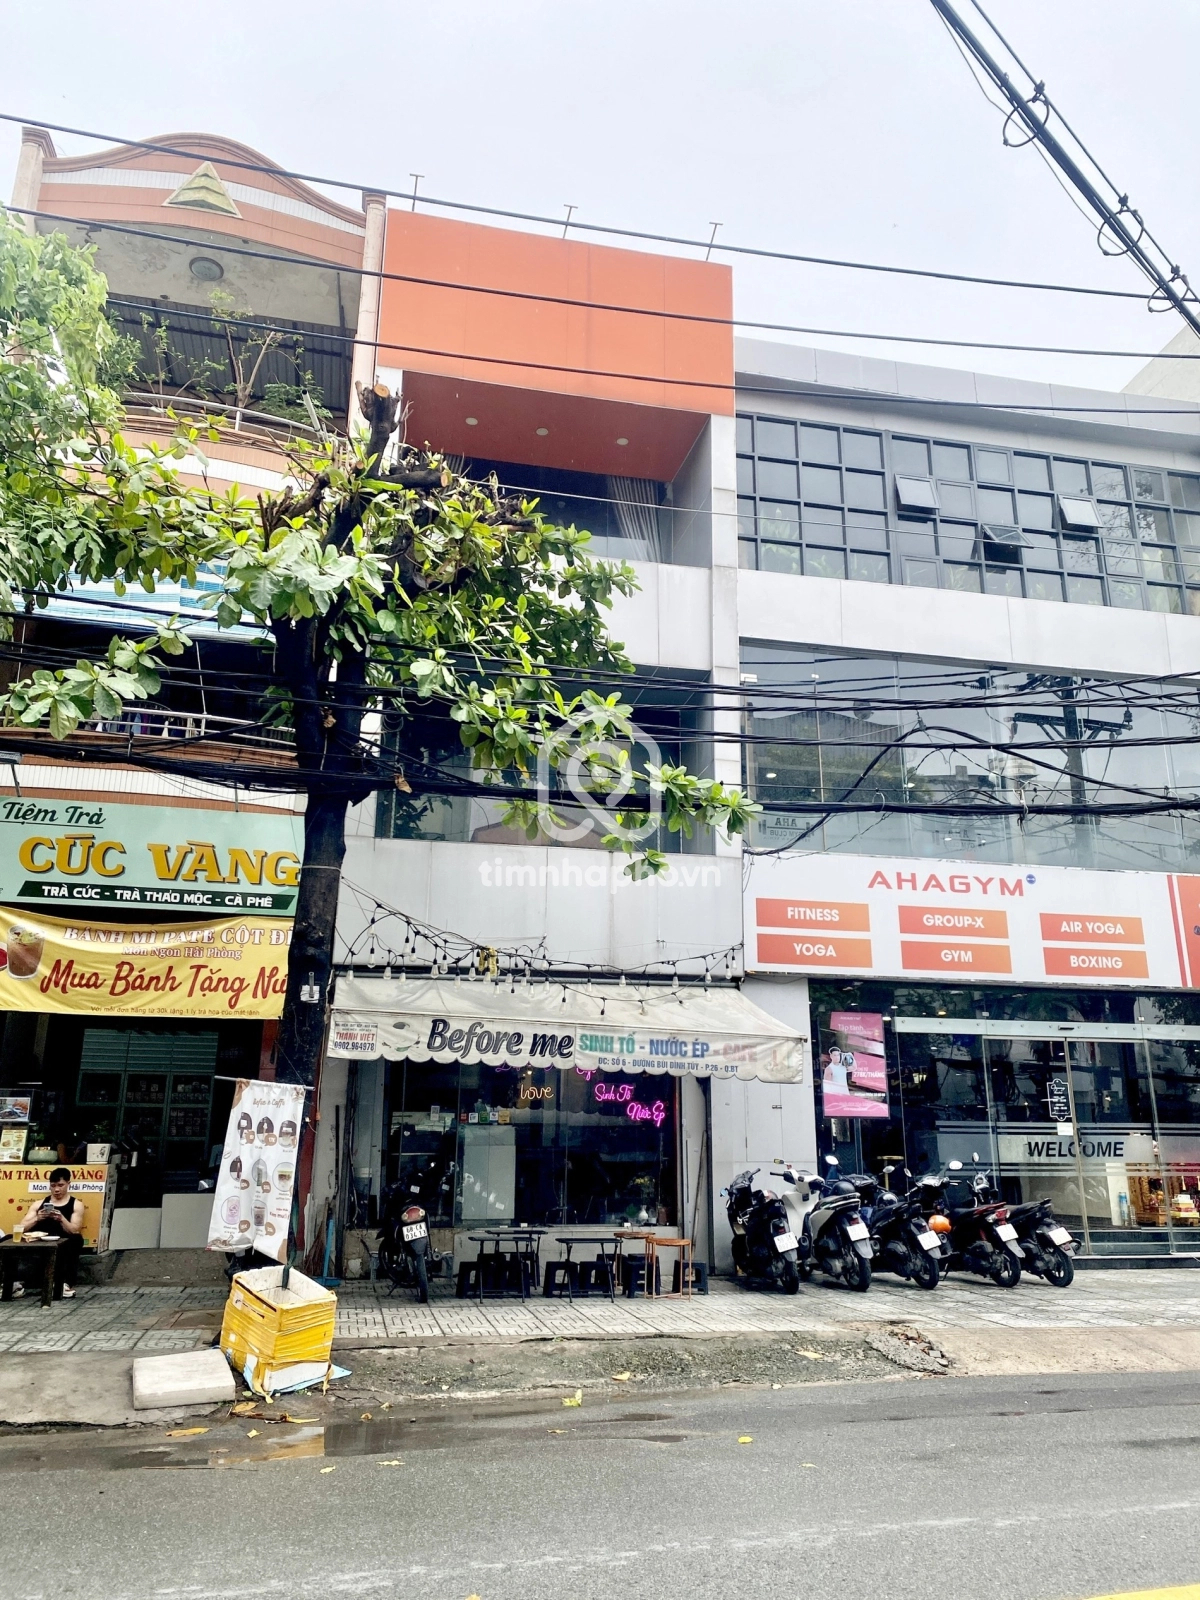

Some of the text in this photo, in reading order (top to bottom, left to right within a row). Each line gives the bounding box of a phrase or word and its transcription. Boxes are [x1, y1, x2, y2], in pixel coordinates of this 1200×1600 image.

[867, 870, 1024, 897] AHAGYM
[42, 884, 69, 897] TRÀ
[73, 885, 100, 899] CÚC
[114, 888, 141, 901] TRÀ
[144, 889, 180, 903] THẢO
[183, 892, 213, 906] MỘC
[225, 893, 243, 906] CÀ
[246, 895, 273, 908] PHÊ
[787, 906, 840, 922] FITNESS
[923, 914, 985, 929] GROUP-X
[63, 926, 125, 943] BÁNH
[130, 929, 158, 944] MÌ
[162, 928, 215, 943] PATE
[220, 924, 264, 948] CỘT
[1061, 921, 1125, 935] AIR YOGA
[150, 946, 180, 959] Ngon
[184, 947, 204, 958] Hải
[207, 947, 243, 960] Phòng
[793, 943, 837, 957] YOGA
[941, 949, 973, 963] GYM
[1070, 955, 1123, 969] BOXING
[39, 958, 106, 994] Mua
[109, 960, 182, 996] Bánh
[187, 964, 250, 1010] Tặng
[427, 1018, 575, 1059] Before me
[579, 1033, 615, 1054] SINH
[617, 1031, 636, 1054] TỐ
[649, 1036, 688, 1057] NƯỚC
[692, 1038, 710, 1058] ÉP
[611, 1056, 620, 1066] SỐ
[621, 1058, 627, 1066] 6
[657, 1059, 668, 1069] BÙI
[705, 1064, 718, 1072] P.26
[725, 1064, 738, 1073] Q.BT
[595, 1083, 615, 1101] Sinh
[627, 1101, 666, 1127] Nước Ép
[1028, 1141, 1124, 1157] WELCOME
[16, 1167, 40, 1180] TRÀ
[71, 1167, 104, 1180] VÀNG
[82, 1183, 104, 1192] Phòng
